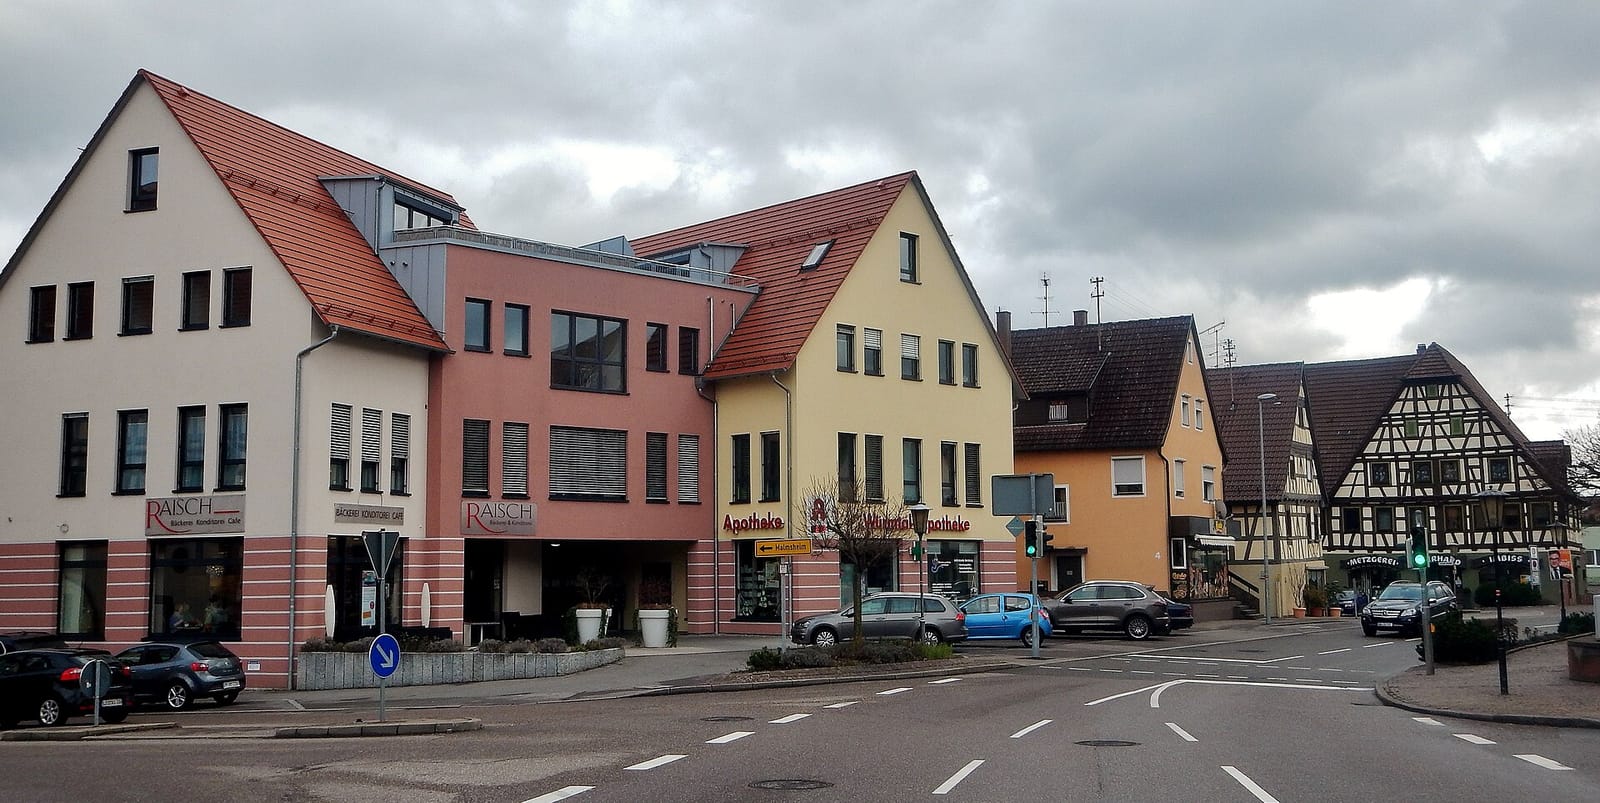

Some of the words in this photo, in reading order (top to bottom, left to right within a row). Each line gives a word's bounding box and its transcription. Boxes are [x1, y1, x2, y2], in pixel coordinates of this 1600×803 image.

[147, 498, 212, 533] RAISCH
[467, 503, 532, 533] RAISCH
[723, 511, 784, 535] Apotheke
[927, 514, 971, 533] potheke
[1349, 556, 1397, 566] METZGEREI
